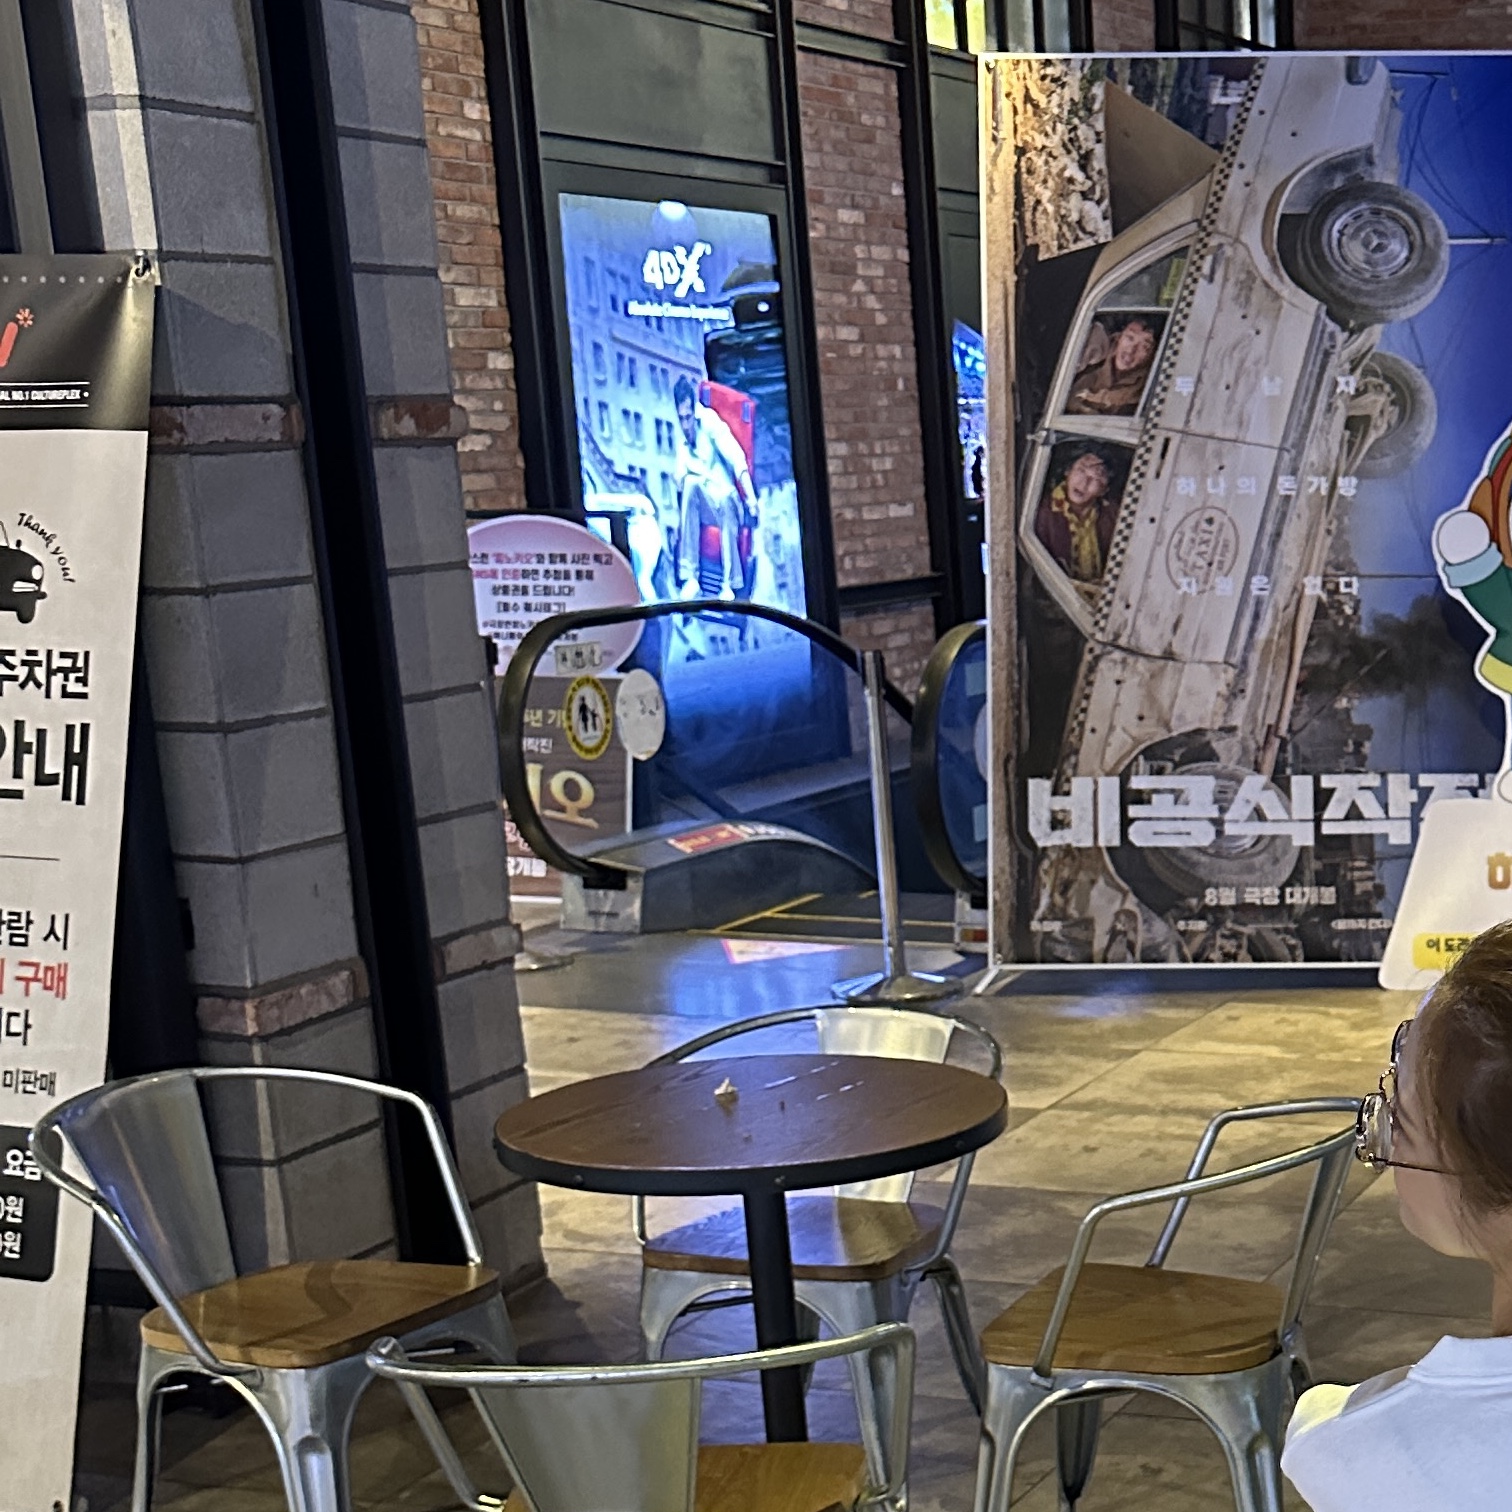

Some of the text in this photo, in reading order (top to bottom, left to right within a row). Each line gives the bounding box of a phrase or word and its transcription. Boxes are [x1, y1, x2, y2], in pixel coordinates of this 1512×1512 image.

[1176, 476, 1358, 496] 하나의 돈가방
[17, 512, 57, 548] Thank
[1205, 886, 1337, 906] 8월 극장 대개봉
[43, 913, 70, 950] 시
[14, 961, 69, 1000] 구매
[0, 1008, 32, 1046] 다
[3, 1067, 57, 1098] 미판매
